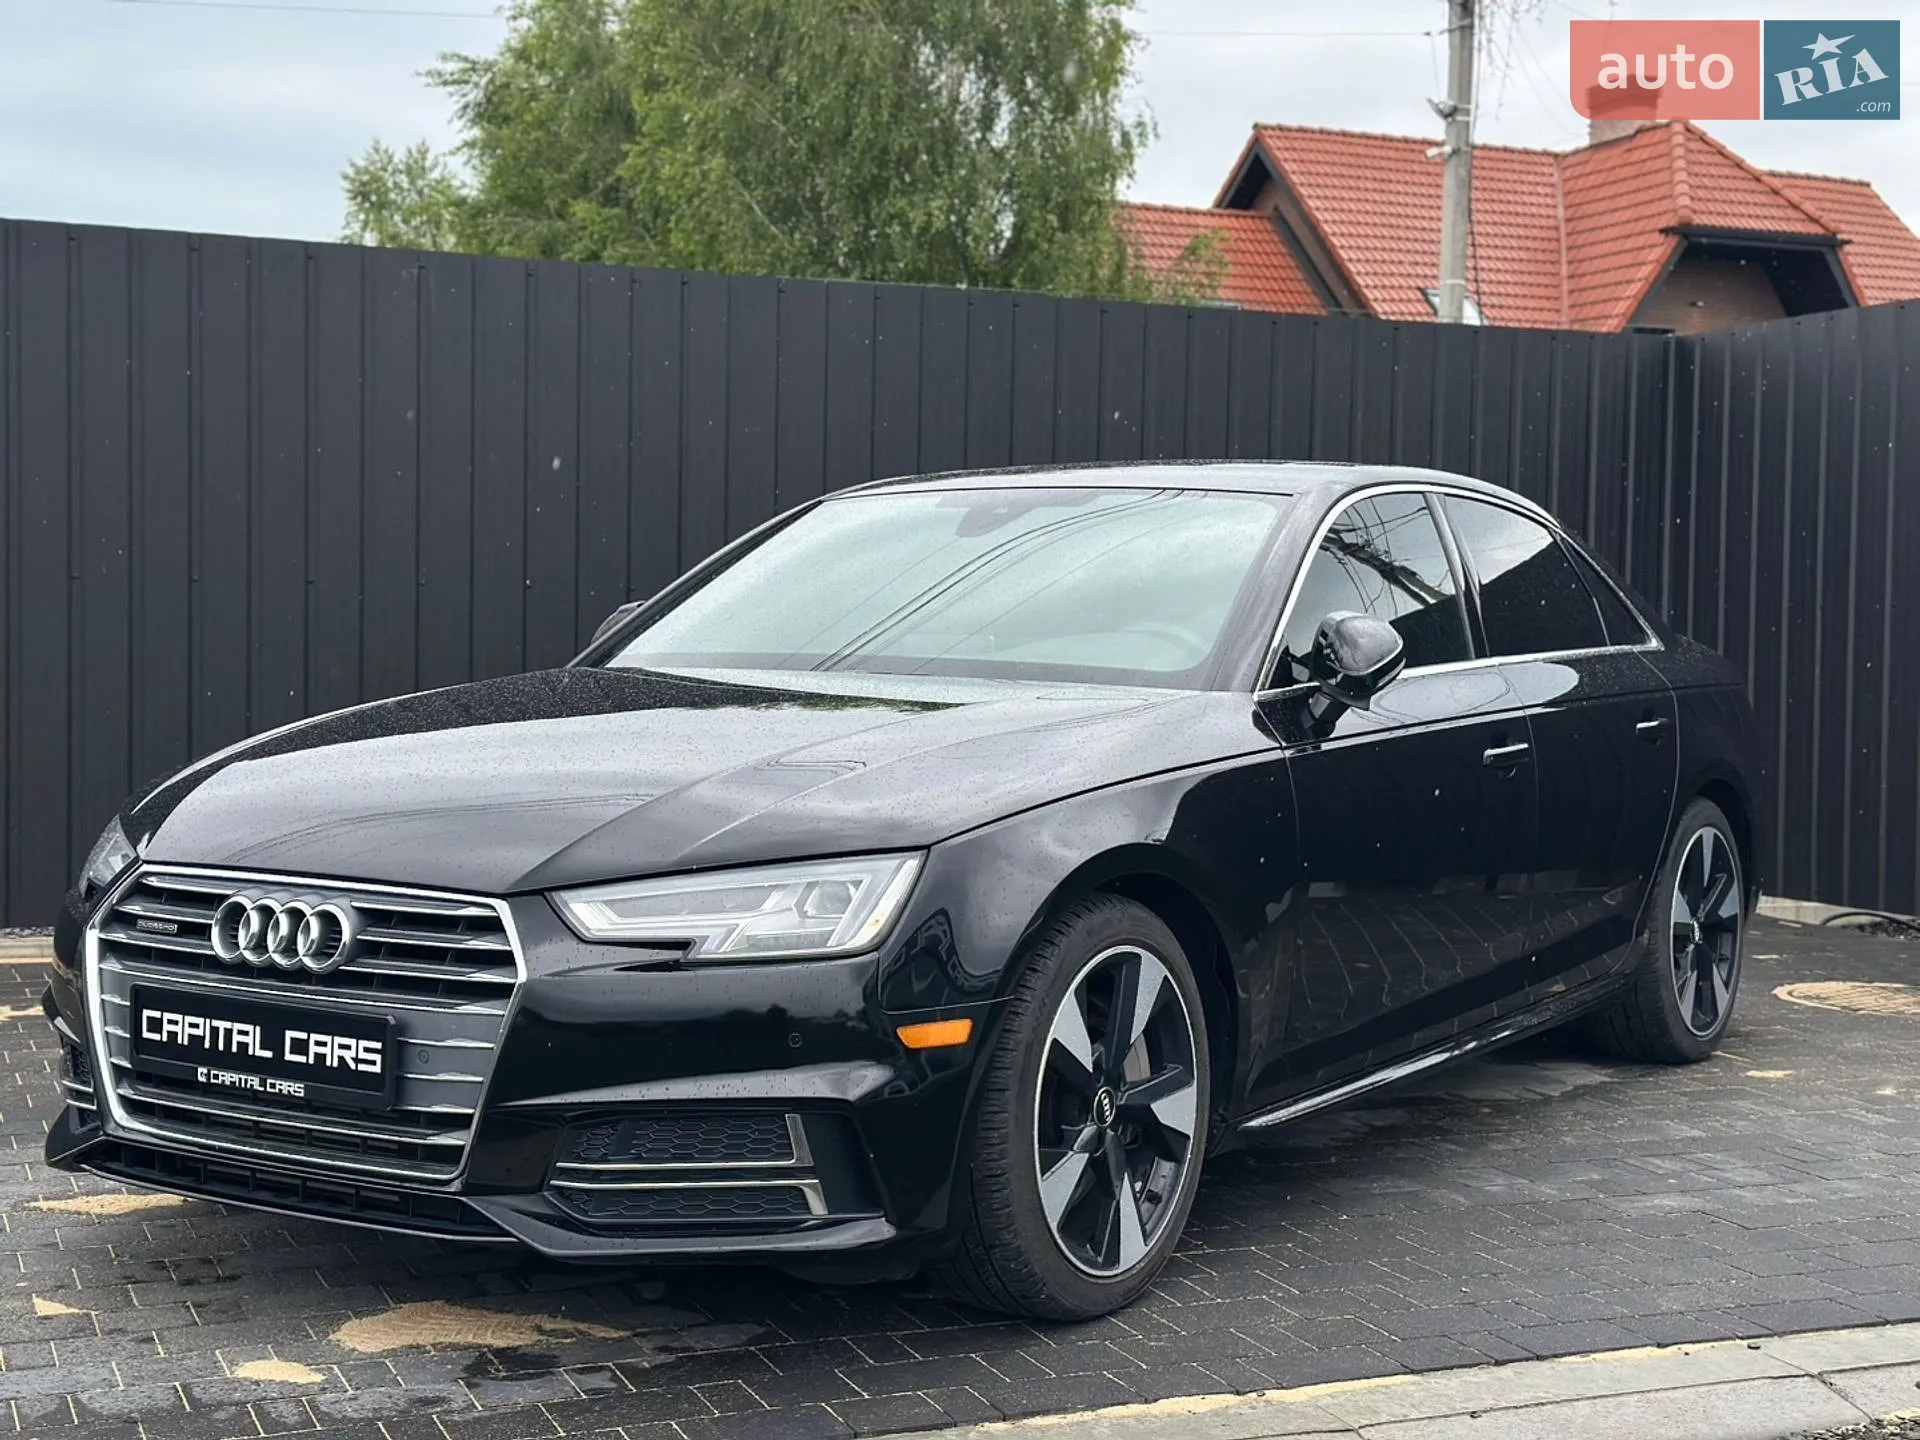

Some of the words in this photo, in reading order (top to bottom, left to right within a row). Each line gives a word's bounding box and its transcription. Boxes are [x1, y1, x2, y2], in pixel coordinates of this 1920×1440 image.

[141, 1008, 273, 1058] CAPITAL
[284, 1030, 383, 1073] CARS
[210, 1070, 264, 1091] CAPITAL
[266, 1079, 304, 1097] CARS
